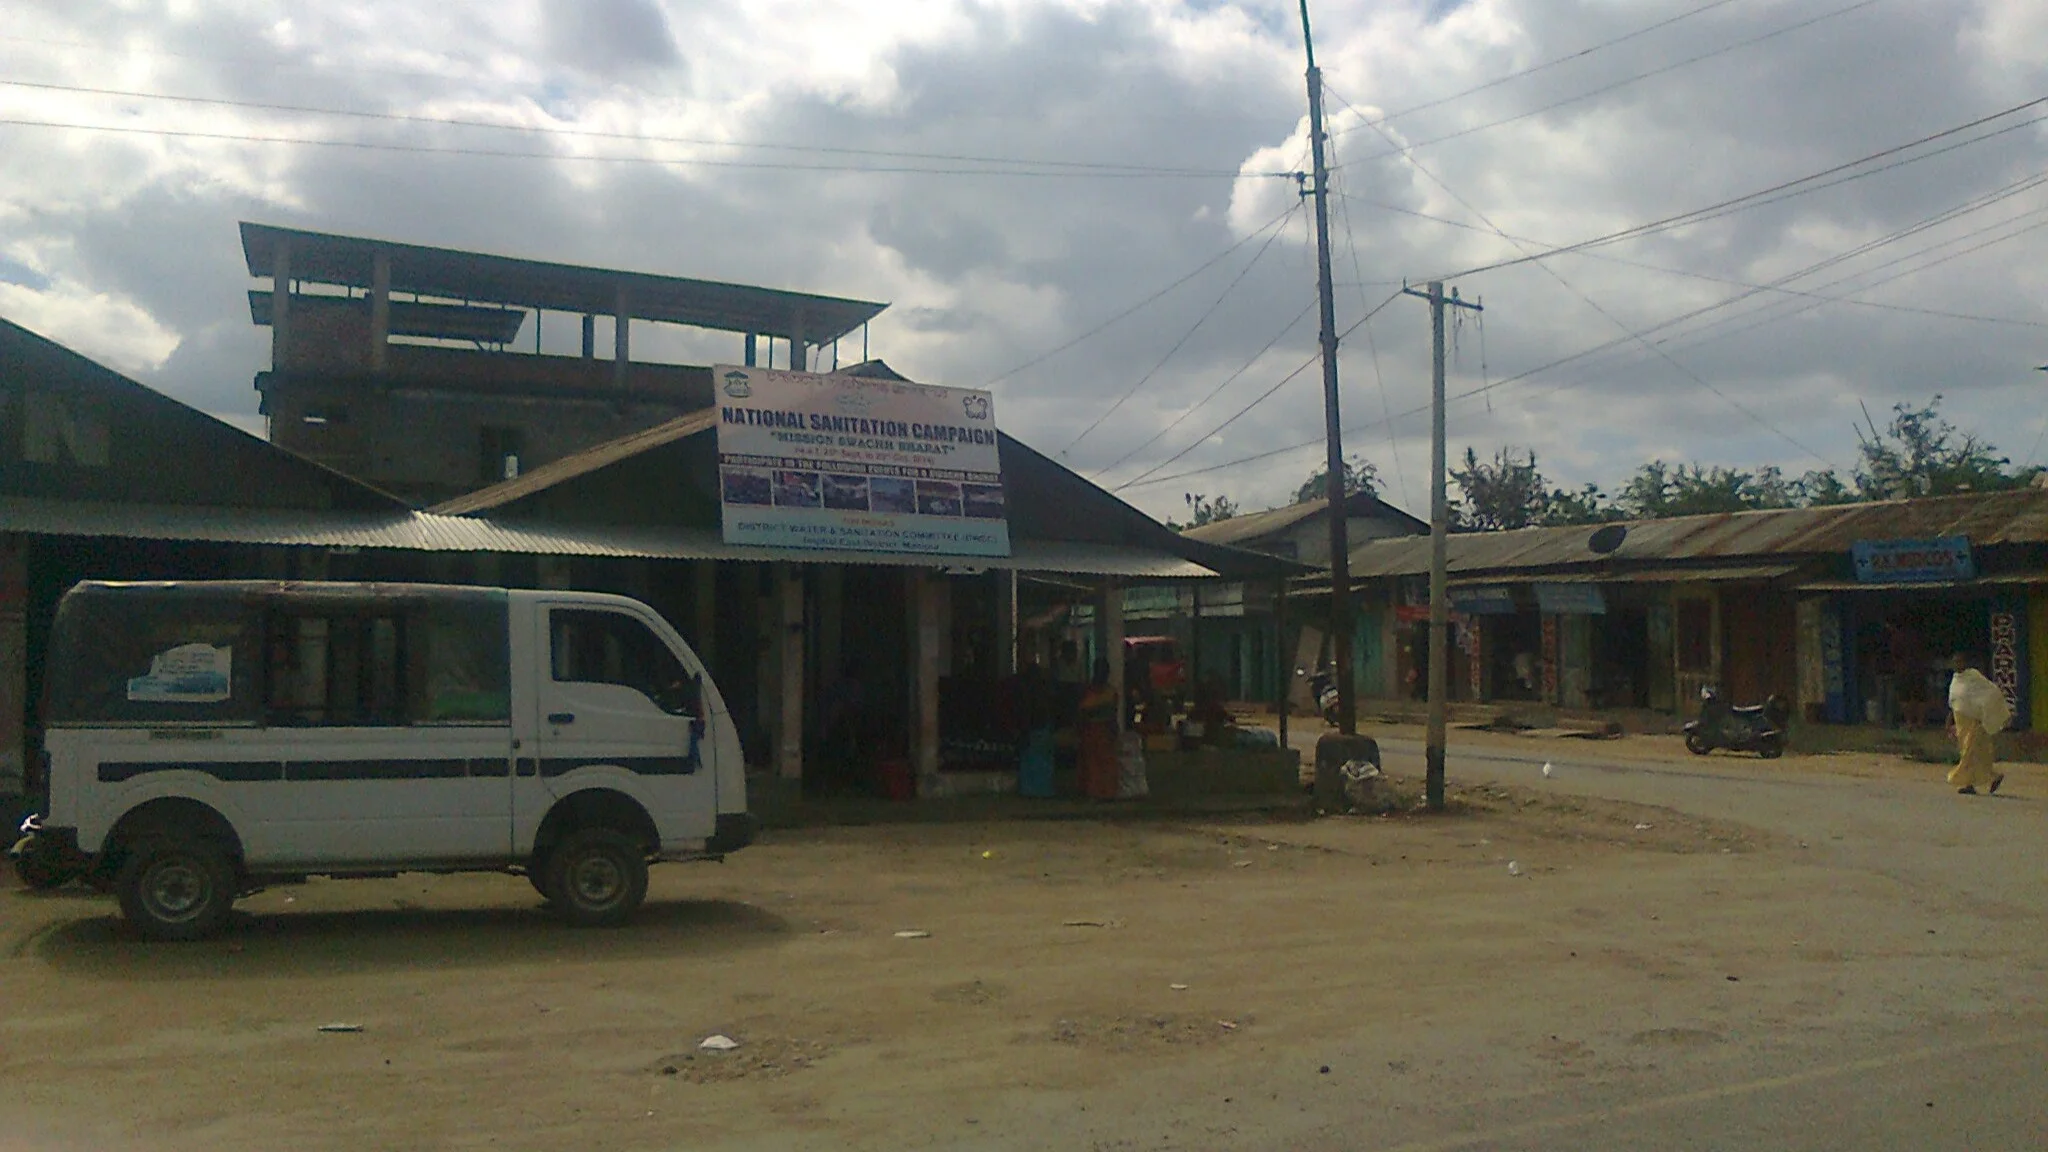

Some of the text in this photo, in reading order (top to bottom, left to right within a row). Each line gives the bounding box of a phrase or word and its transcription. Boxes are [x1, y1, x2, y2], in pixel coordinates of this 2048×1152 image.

[721, 406, 995, 445] NATIONAL SANITATION CAMPAIGN
[789, 524, 828, 534] WATER
